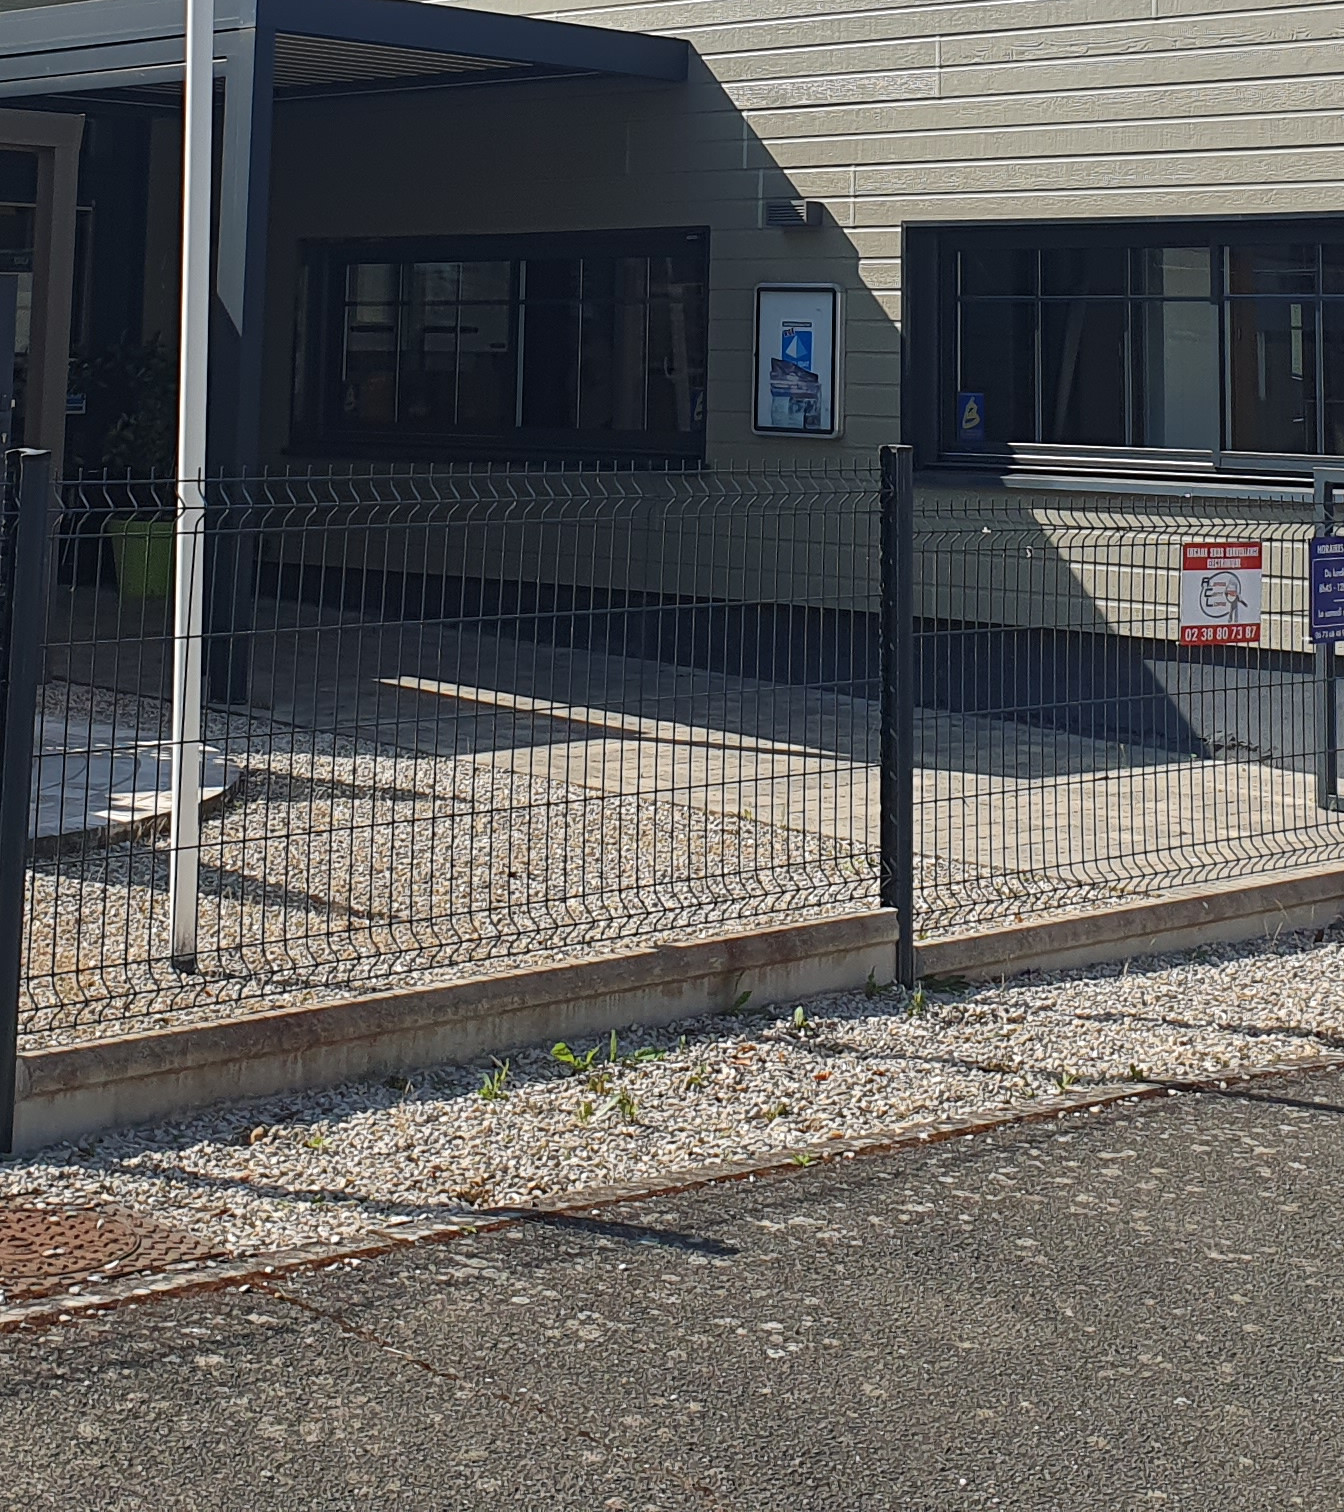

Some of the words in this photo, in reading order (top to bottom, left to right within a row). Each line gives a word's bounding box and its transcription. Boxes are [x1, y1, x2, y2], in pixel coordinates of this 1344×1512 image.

[1185, 628, 1198, 641] 02
[1201, 627, 1213, 640] 38
[1216, 627, 1228, 639] 80
[1231, 626, 1242, 639] 73
[1245, 626, 1257, 638] 87
